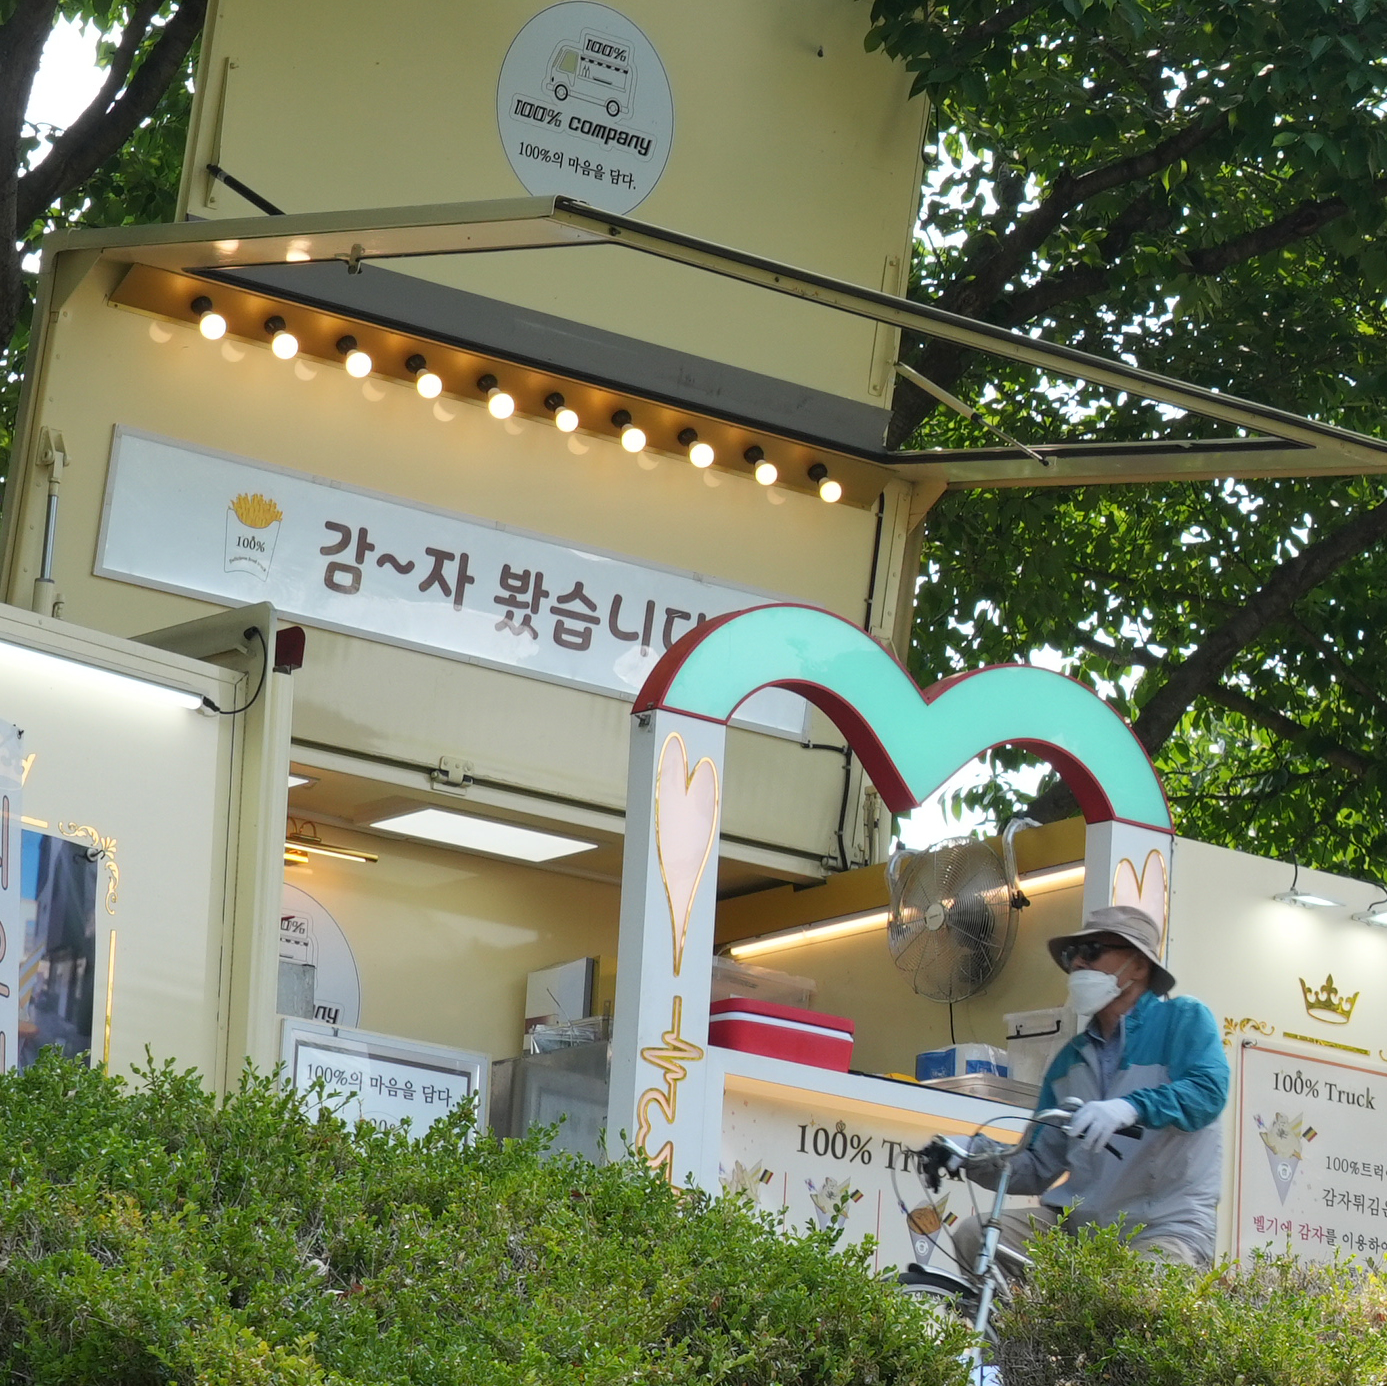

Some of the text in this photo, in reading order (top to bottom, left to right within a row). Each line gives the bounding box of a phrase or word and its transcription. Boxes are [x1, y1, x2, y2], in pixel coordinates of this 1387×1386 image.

[585, 38, 628, 62] 100%
[513, 99, 653, 157] 100% company
[518, 142, 637, 190] 100%의 마음을 담다.
[236, 536, 266, 553] 100%
[370, 1075, 417, 1100] 마음을
[1273, 1070, 1377, 1111] 100% Truck
[797, 1120, 873, 1165] 100%
[1253, 1215, 1292, 1236] 벨기에
[1298, 1223, 1338, 1246] 감자를
